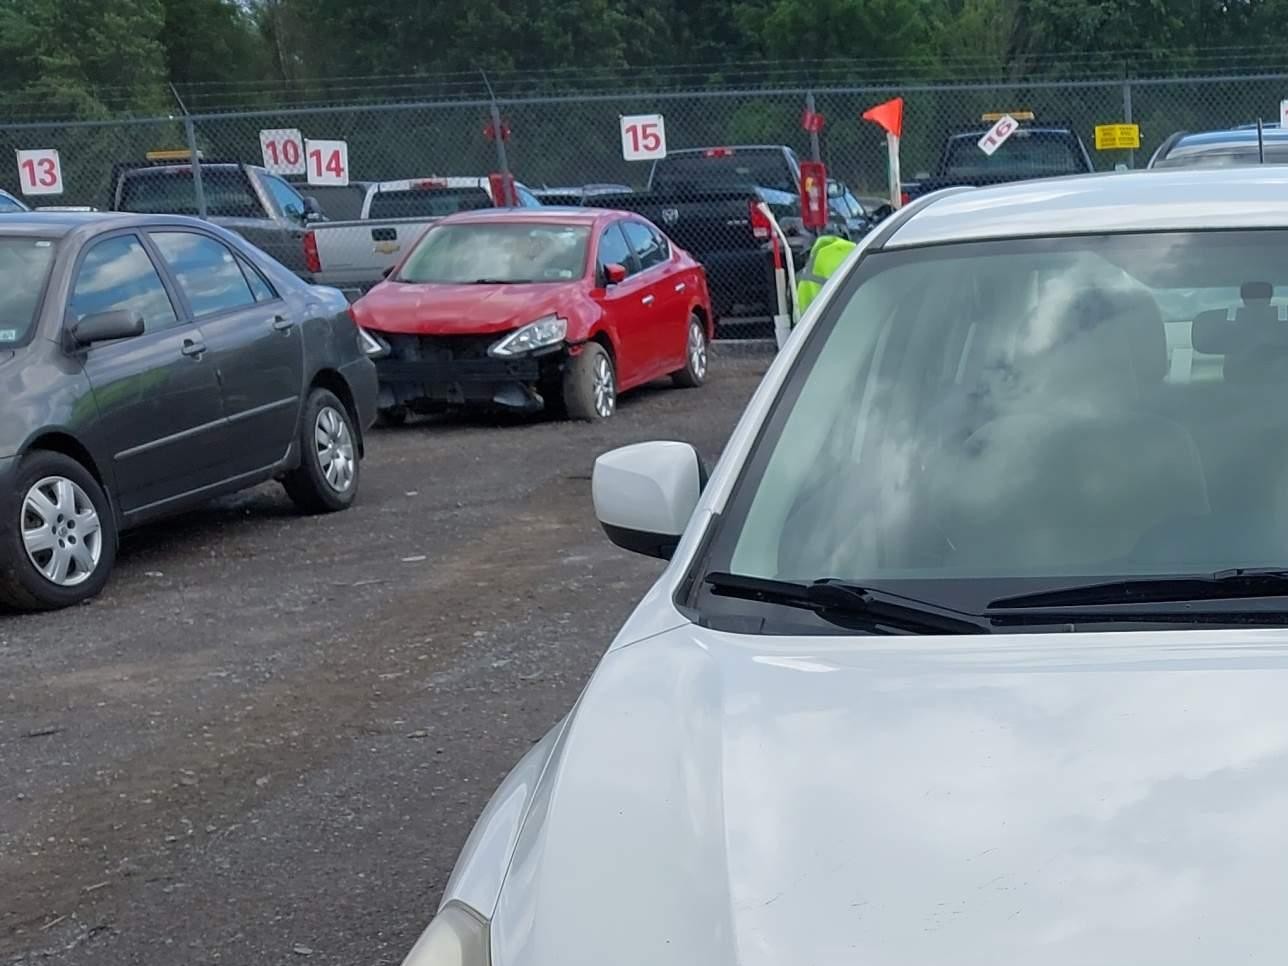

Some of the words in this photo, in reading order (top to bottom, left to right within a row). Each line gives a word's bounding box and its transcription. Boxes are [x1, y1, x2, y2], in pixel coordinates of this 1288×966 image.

[625, 123, 661, 152] 15
[983, 120, 1012, 147] 16
[266, 139, 299, 166] 10
[310, 149, 345, 178] 14
[22, 158, 58, 187] 13
